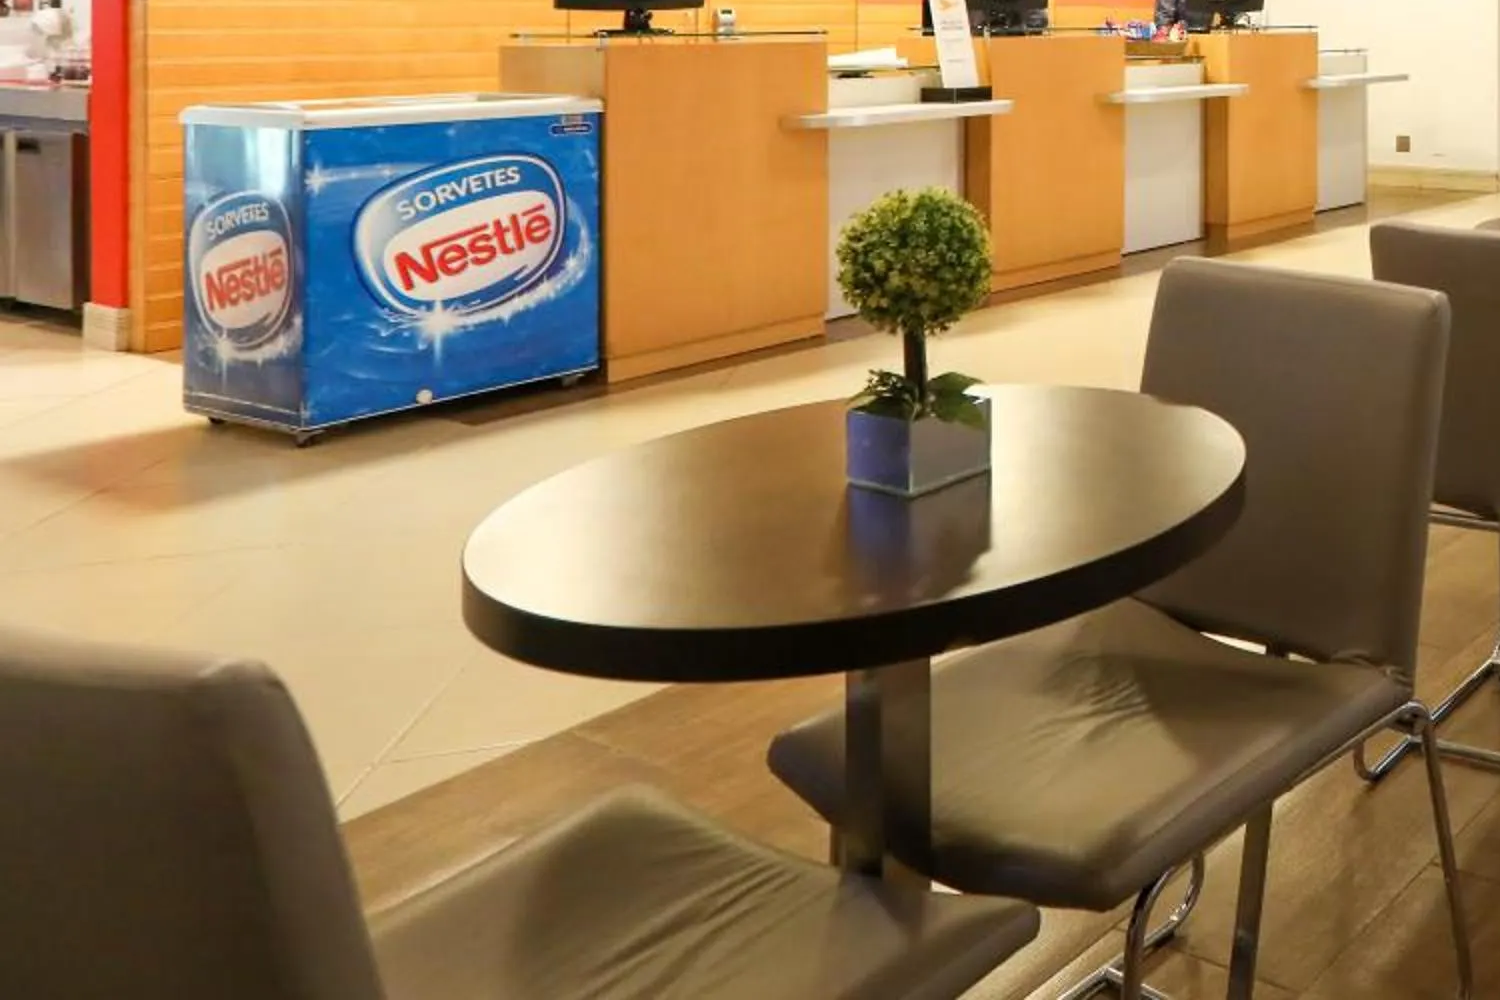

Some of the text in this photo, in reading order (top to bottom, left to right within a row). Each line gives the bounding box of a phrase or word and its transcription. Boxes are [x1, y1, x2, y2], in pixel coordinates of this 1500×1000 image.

[207, 202, 270, 240] SORVETES
[396, 166, 521, 220] SORVETES
[395, 203, 551, 291] Nestlé
[205, 247, 286, 311] Nestlé
